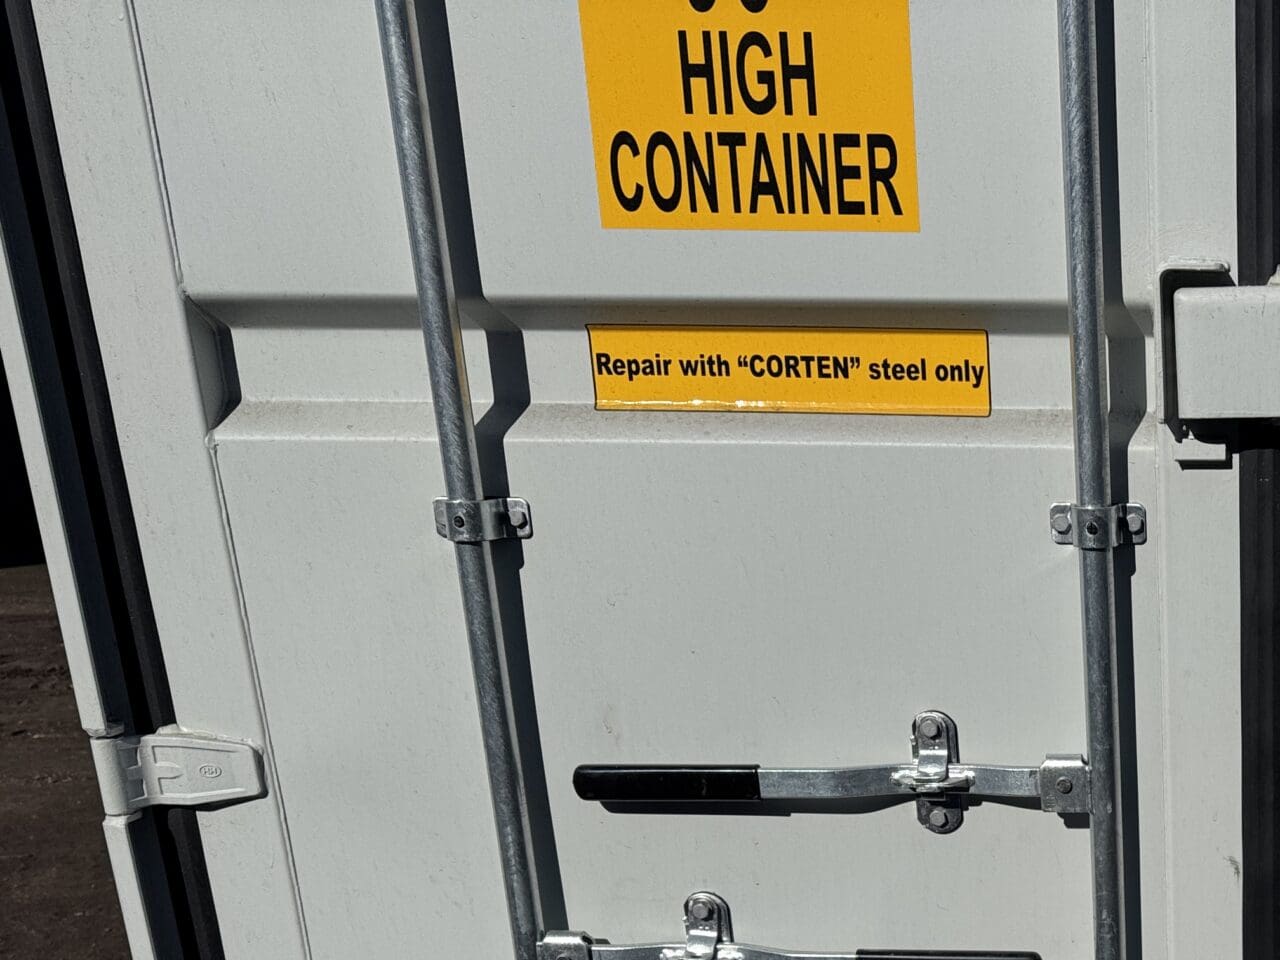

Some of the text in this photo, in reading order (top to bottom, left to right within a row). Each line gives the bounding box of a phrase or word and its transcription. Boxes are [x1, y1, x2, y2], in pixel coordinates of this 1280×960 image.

[677, 29, 818, 117] HIGH
[609, 130, 904, 216] CONTAINER
[595, 352, 672, 381] Repair
[679, 353, 731, 377] with
[868, 358, 927, 381] steel
[935, 359, 985, 388] only
